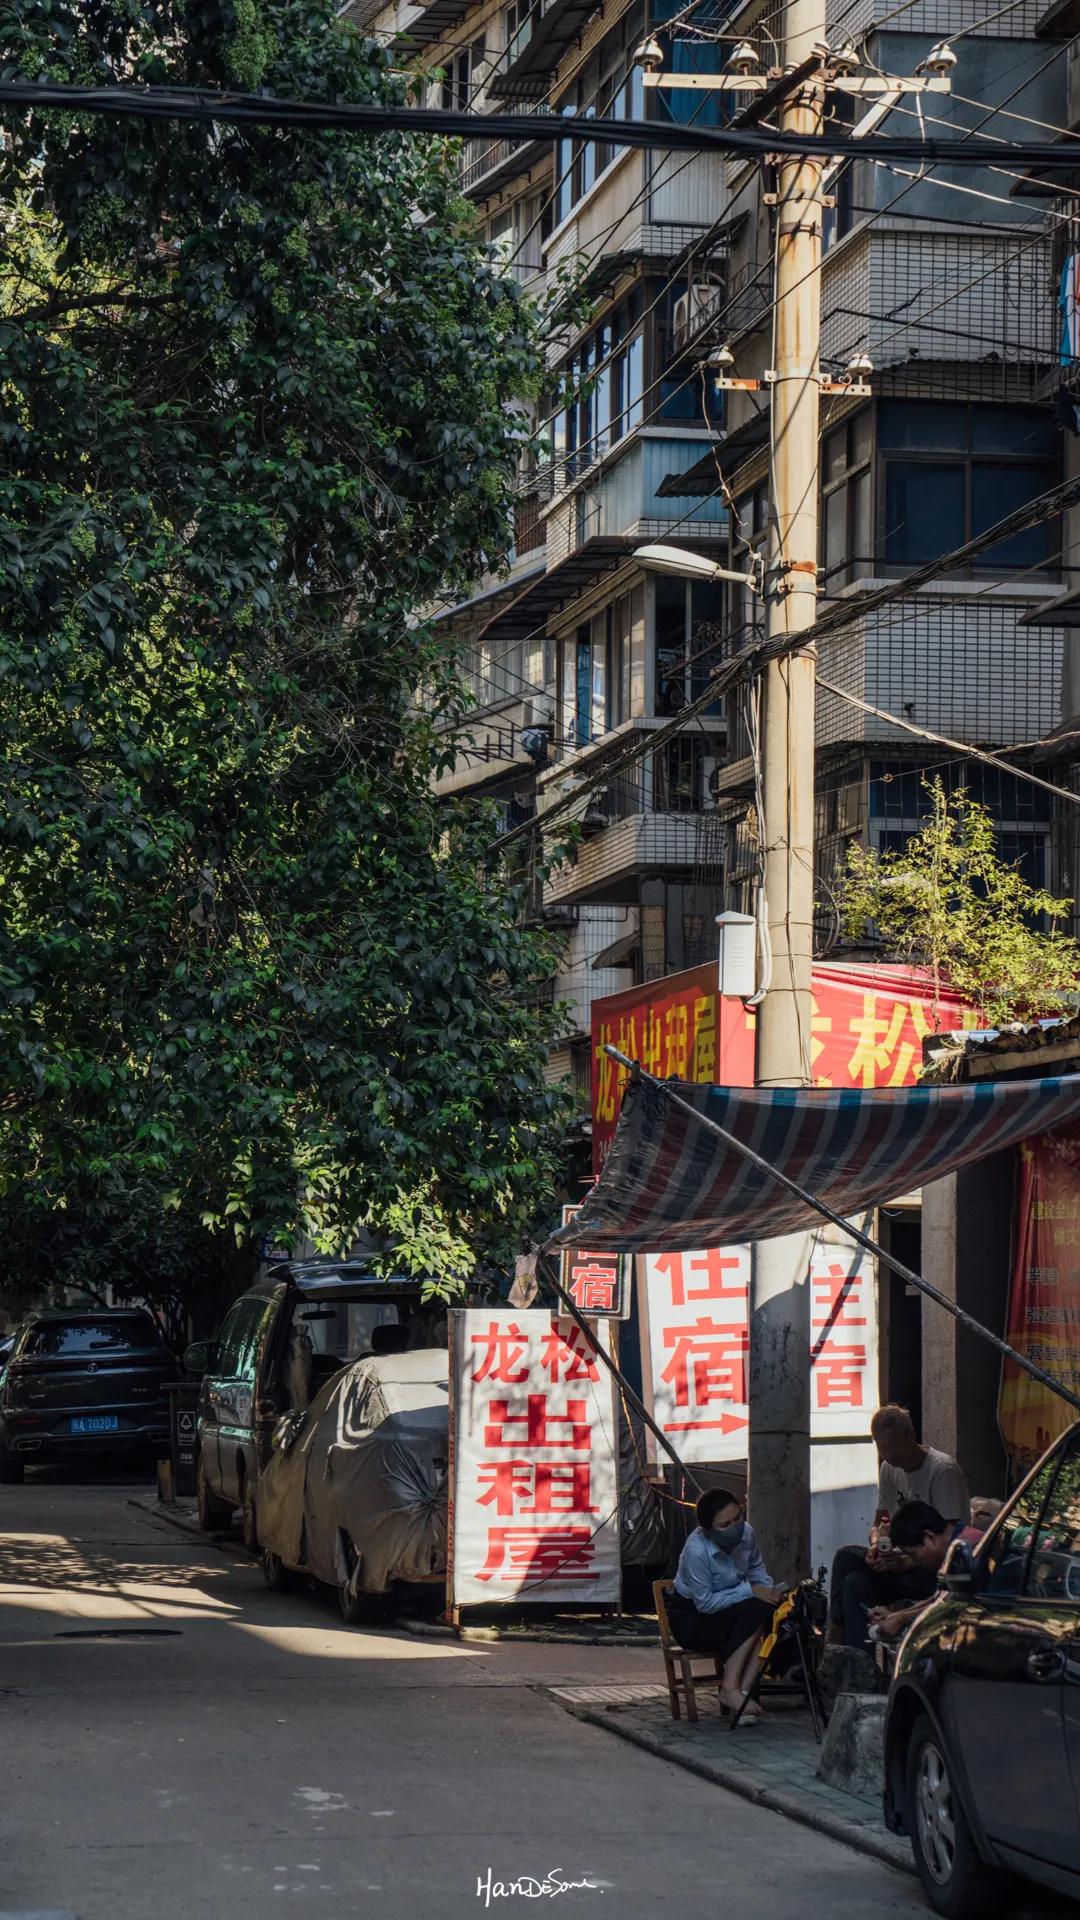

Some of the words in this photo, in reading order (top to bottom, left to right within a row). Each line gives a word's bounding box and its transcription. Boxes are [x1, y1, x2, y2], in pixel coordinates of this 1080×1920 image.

[471, 1322, 601, 1384] 龙松
[654, 1248, 749, 1407] 住宿
[473, 1394, 601, 1582] 出租屋
